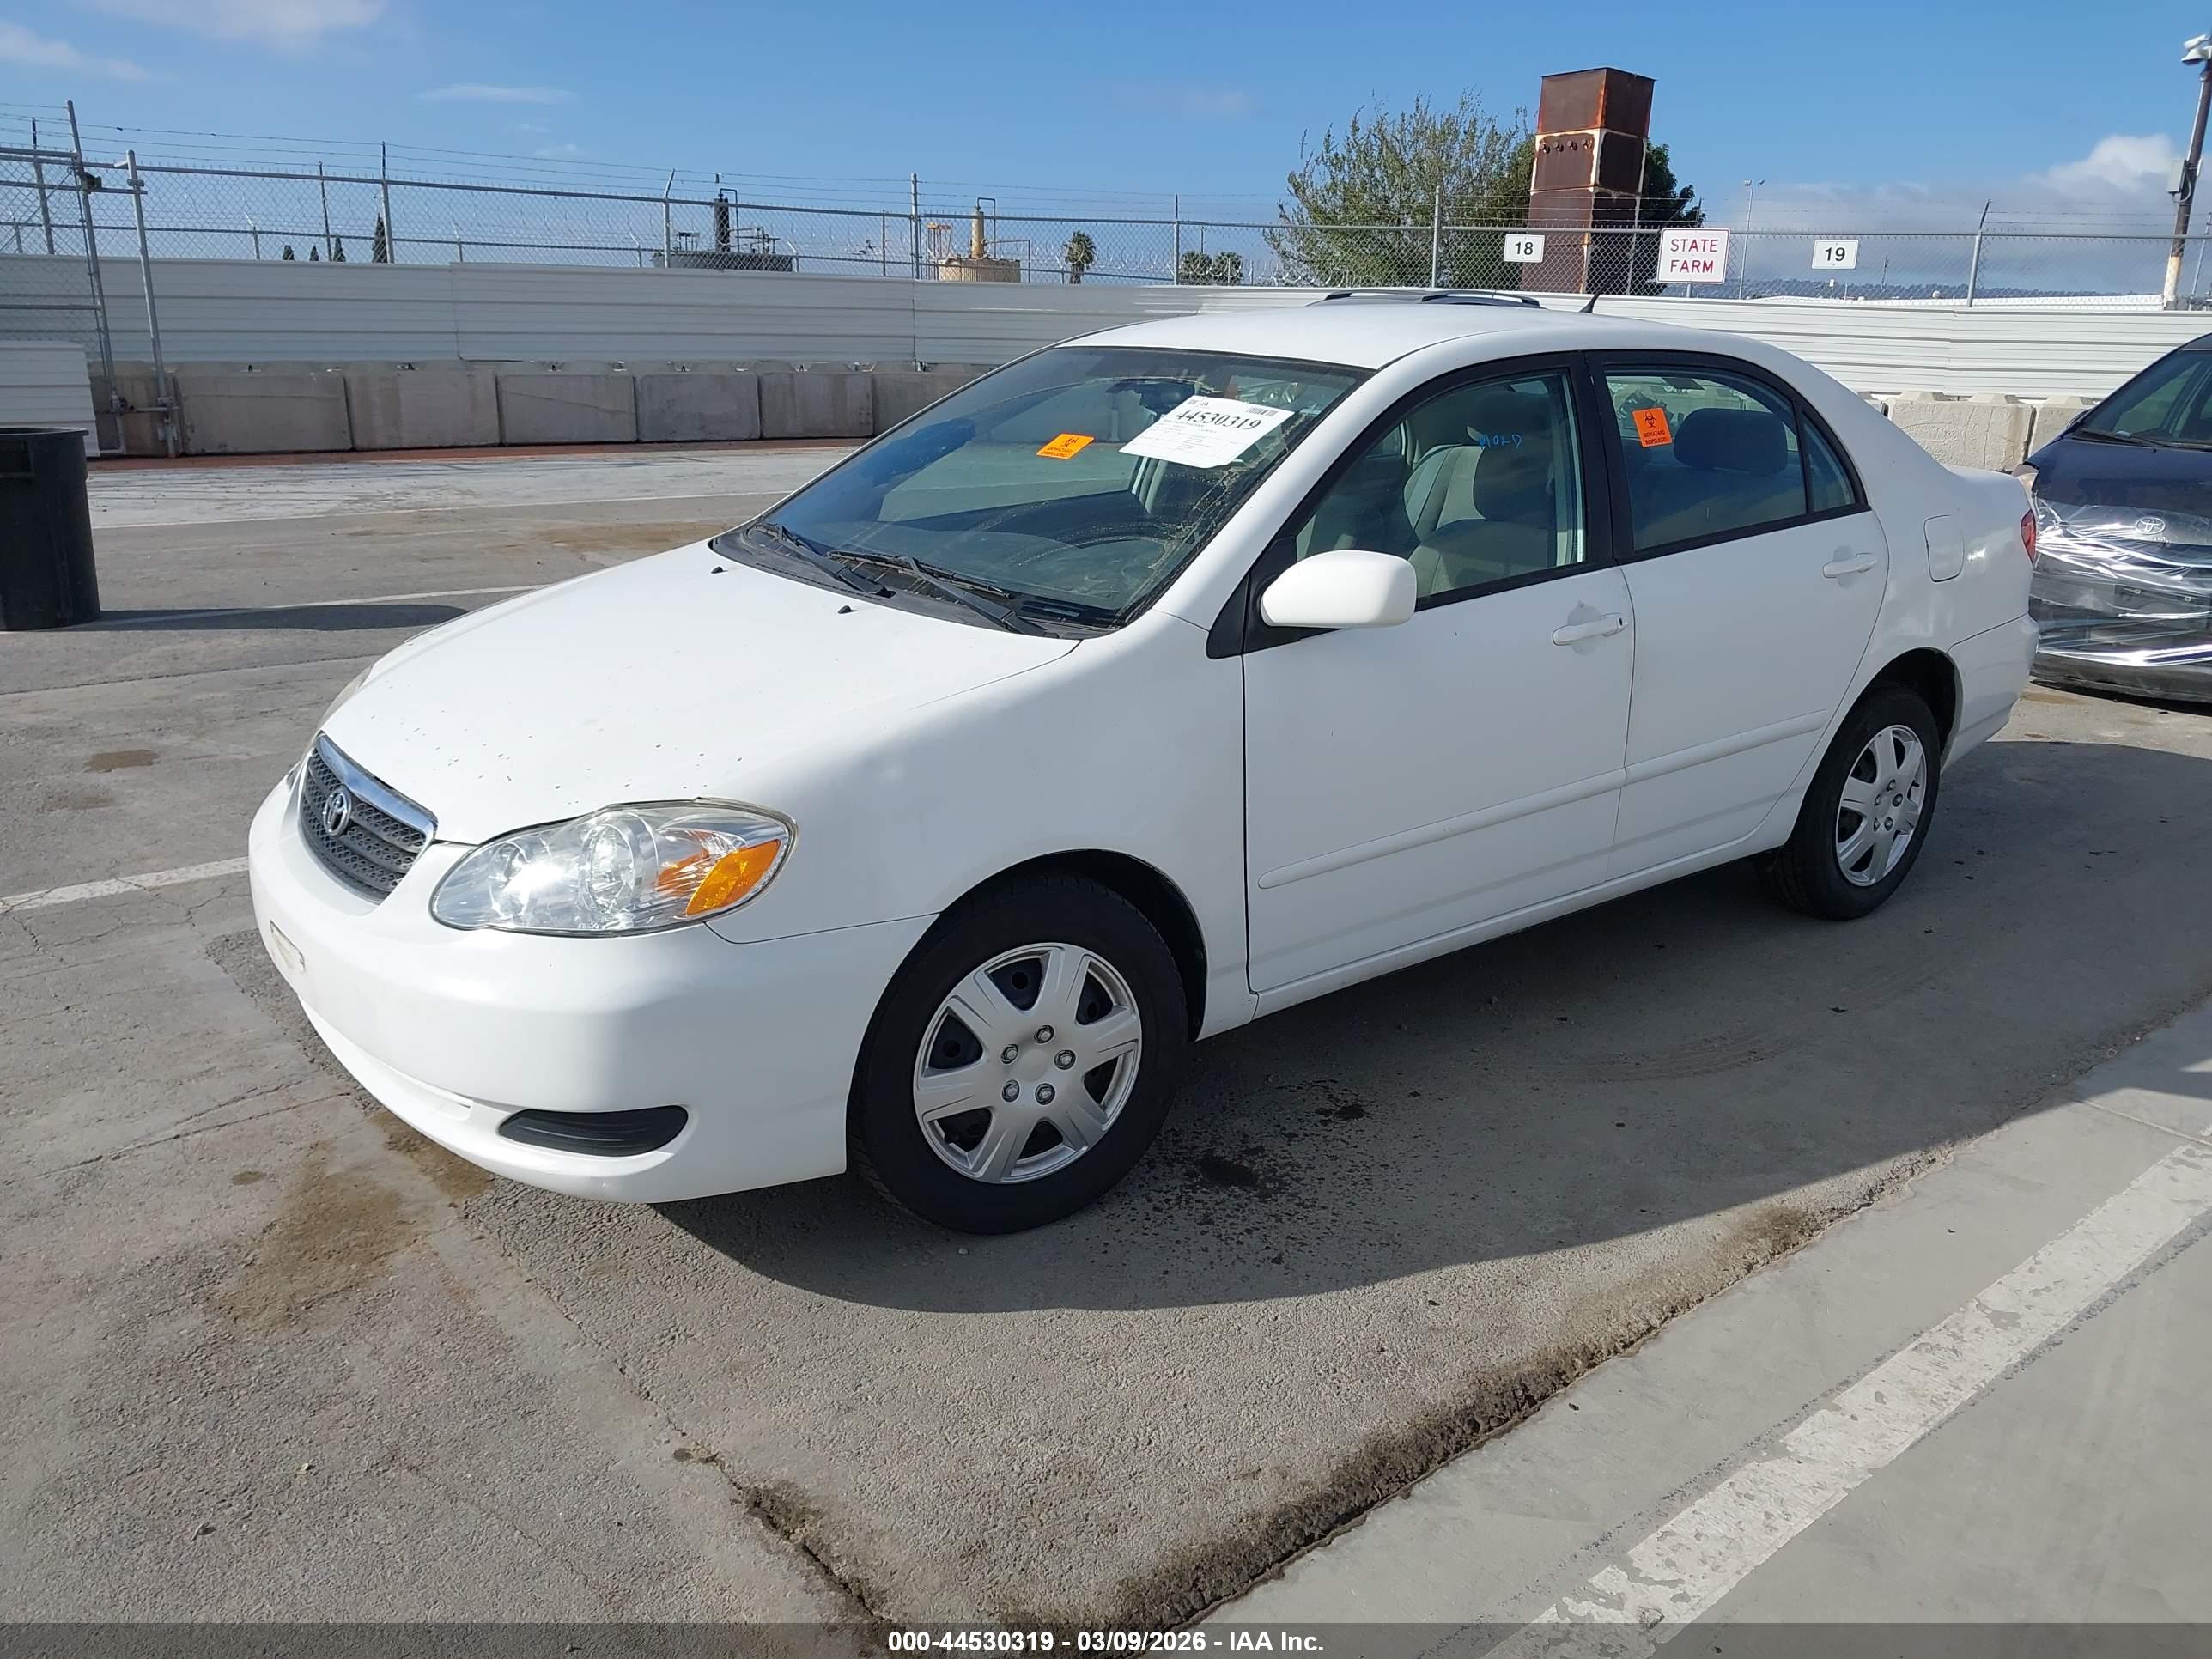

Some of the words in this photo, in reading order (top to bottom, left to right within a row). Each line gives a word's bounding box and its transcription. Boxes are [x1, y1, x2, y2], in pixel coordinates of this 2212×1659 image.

[1515, 240, 1534, 256] 18
[1670, 238, 1720, 252] STATE
[1825, 246, 1845, 262] 19
[1670, 259, 1715, 274] FARM
[1175, 409, 1262, 429] 44530319
